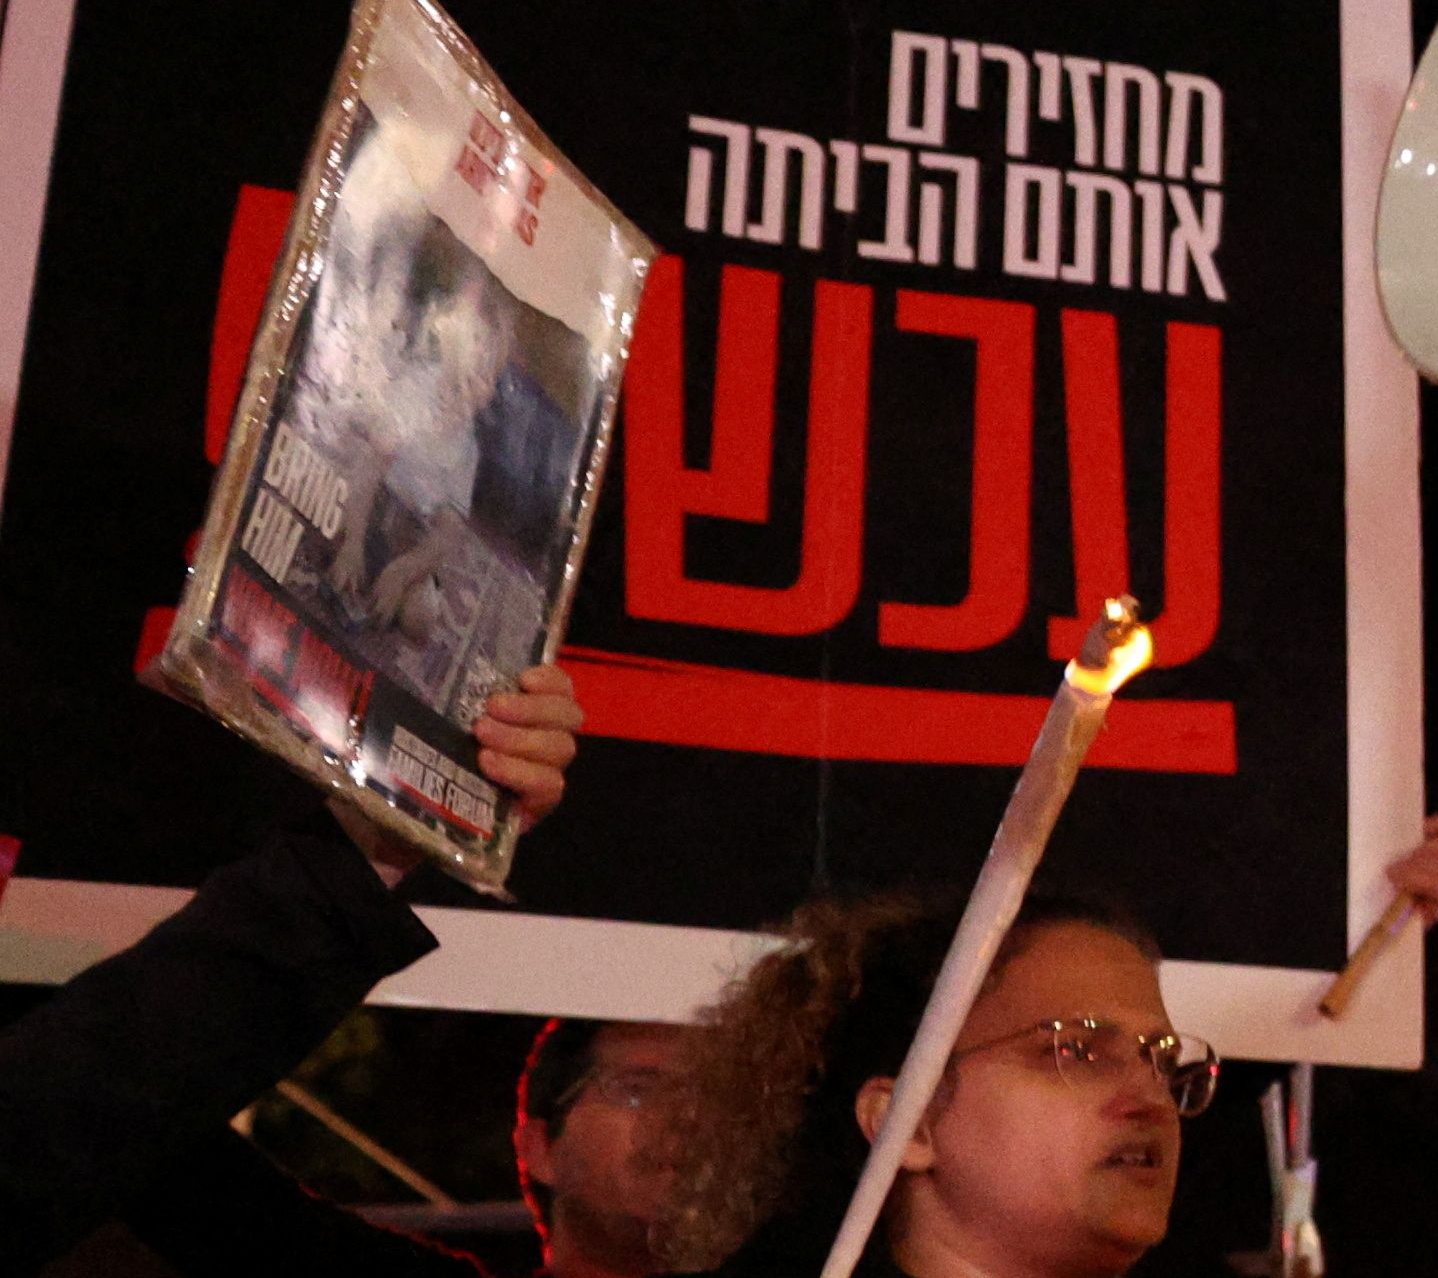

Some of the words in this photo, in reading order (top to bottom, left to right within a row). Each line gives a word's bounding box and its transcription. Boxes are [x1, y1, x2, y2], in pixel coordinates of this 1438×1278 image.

[887, 29, 1224, 185] מחזירים
[685, 114, 980, 270] הביתה
[1002, 161, 1227, 302] אותם
[241, 485, 305, 585] HIM
[262, 423, 349, 542] BRING
